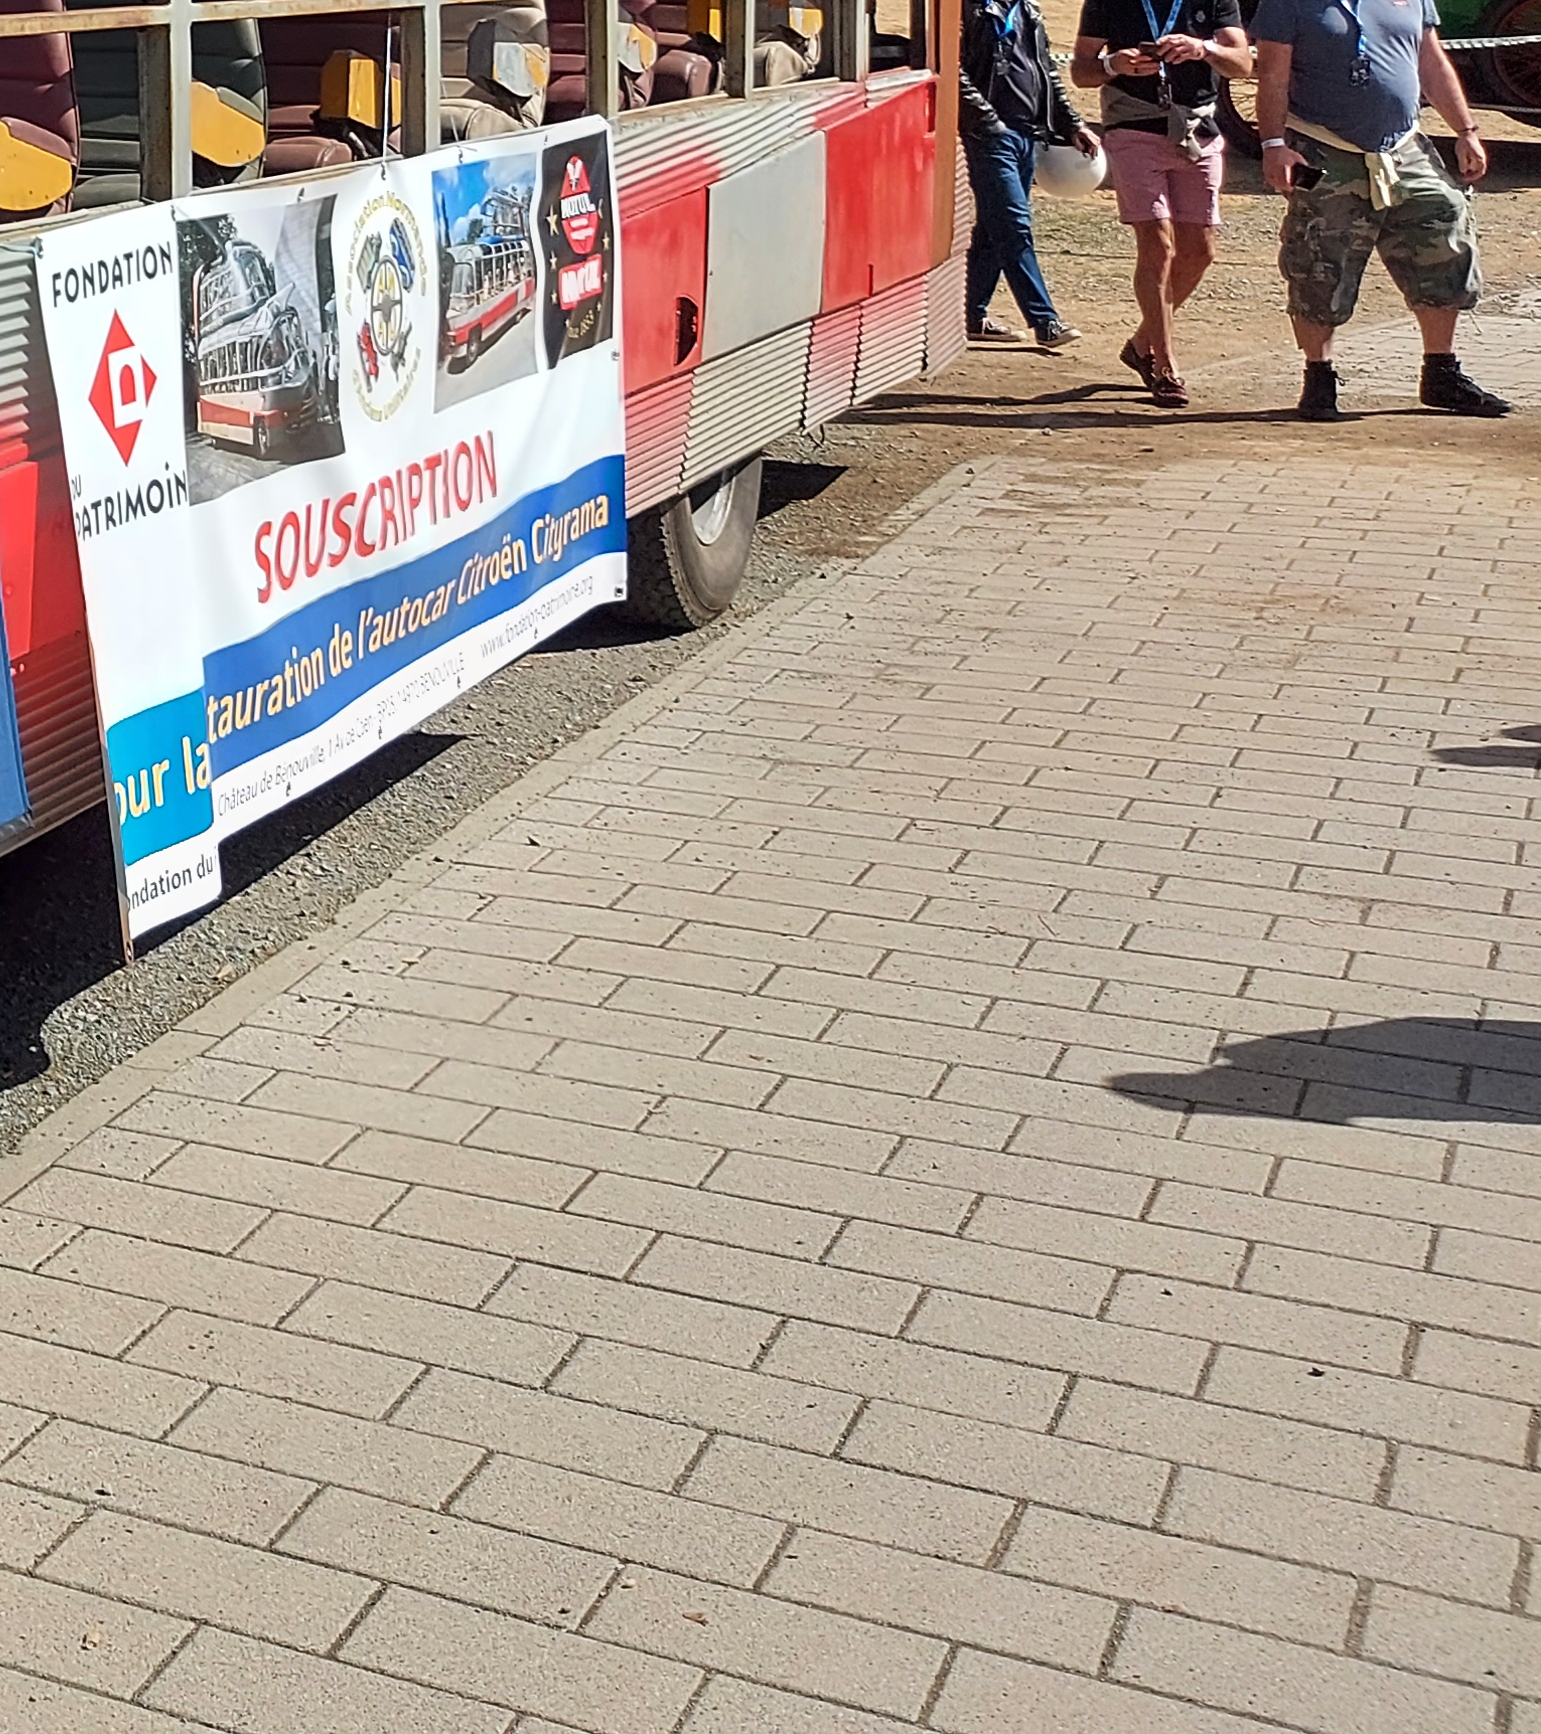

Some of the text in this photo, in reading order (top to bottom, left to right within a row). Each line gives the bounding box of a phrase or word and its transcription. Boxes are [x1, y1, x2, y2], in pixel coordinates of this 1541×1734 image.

[51, 241, 173, 308] FONDATION
[253, 429, 499, 605] SOUSCRIPTION
[328, 623, 354, 678] de
[357, 578, 458, 661] l'autocar
[456, 533, 528, 606] Citroën
[530, 494, 610, 564] Cityrama
[218, 781, 258, 817] Château
[260, 771, 273, 794] de
[196, 853, 214, 880] du
